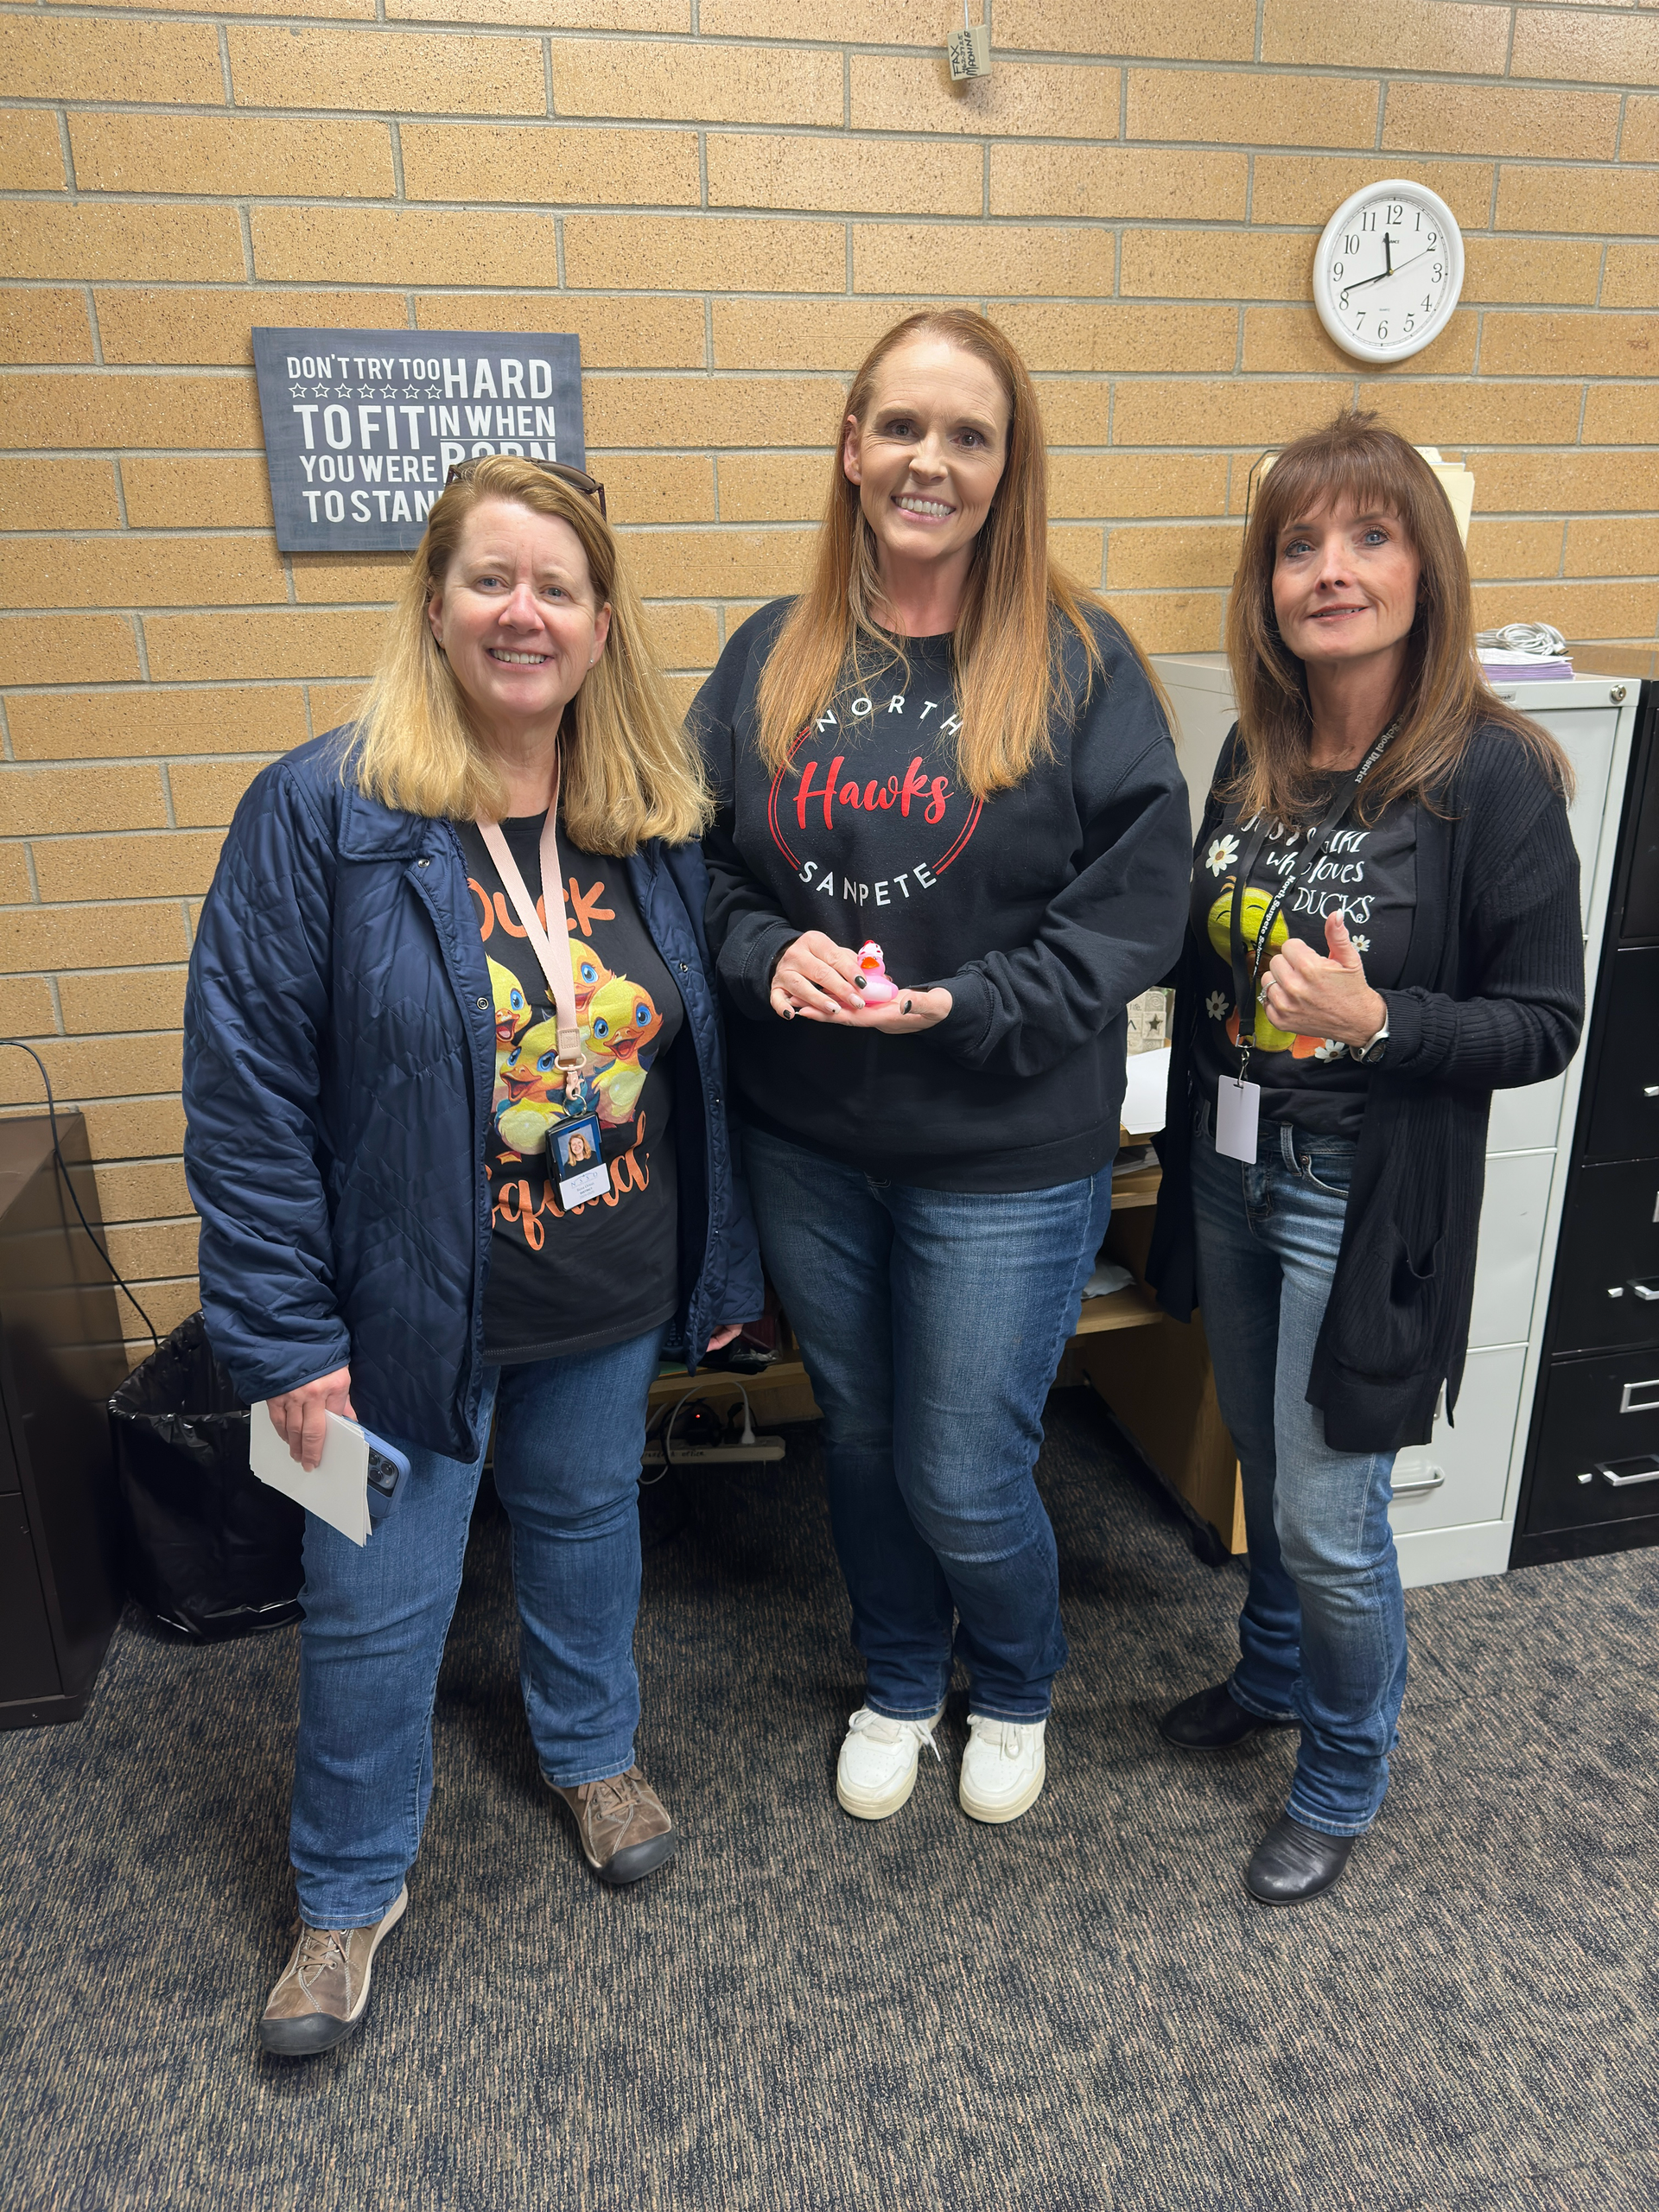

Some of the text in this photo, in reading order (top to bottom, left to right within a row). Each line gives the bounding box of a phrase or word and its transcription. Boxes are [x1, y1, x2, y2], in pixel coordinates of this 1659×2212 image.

[950, 45, 962, 77] FAX
[964, 30, 979, 76] MACHINE
[1361, 212, 1376, 232] 11
[1385, 205, 1403, 226] 12
[1414, 213, 1421, 232] 1
[1344, 234, 1360, 255] 10
[1427, 232, 1437, 251] 2
[1333, 262, 1344, 282] 9
[1432, 263, 1443, 283] 3
[1338, 289, 1350, 311] 8
[1421, 294, 1432, 312] 4
[1356, 311, 1366, 330] 7
[1377, 320, 1389, 340] 6
[1403, 313, 1415, 332] 5
[286, 353, 553, 399] DON'T TRY TOO HARD
[293, 404, 556, 450] TO FIT IN WHEN
[299, 454, 355, 483] YOU
[359, 454, 438, 483] WERE
[302, 490, 444, 523] TO STAN
[815, 695, 963, 736] NORTH
[1354, 723, 1400, 784] School District
[792, 755, 955, 830] Hawks
[1307, 855, 1365, 884] loves
[798, 861, 938, 906] SANPETE
[1274, 874, 1296, 900] North
[1261, 899, 1281, 935] Sanpete
[1291, 887, 1376, 924] DUCKS
